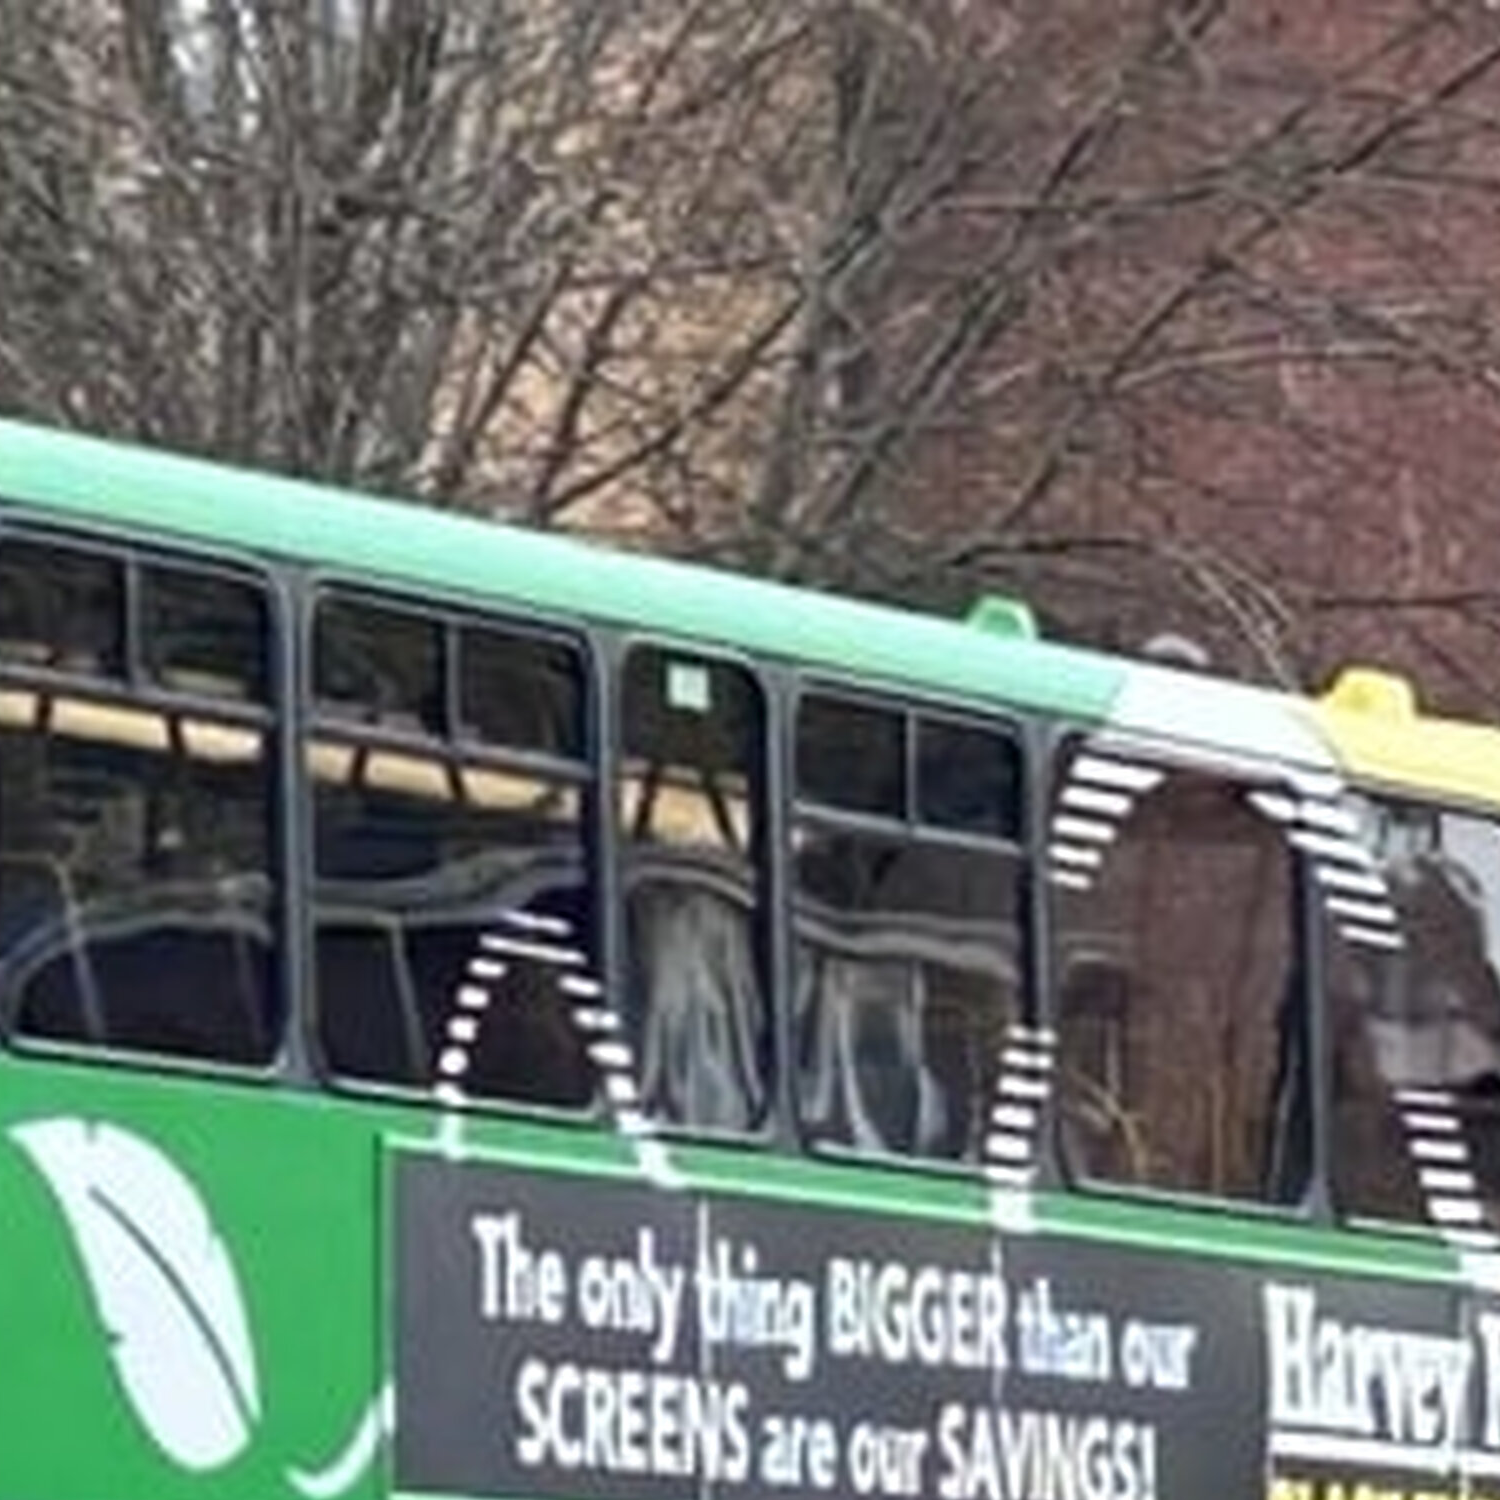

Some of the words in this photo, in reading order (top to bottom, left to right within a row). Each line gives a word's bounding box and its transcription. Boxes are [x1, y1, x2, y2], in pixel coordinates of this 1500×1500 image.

[472, 1212, 566, 1323] The
[578, 1228, 684, 1363] only
[696, 1240, 815, 1381] thing
[827, 1257, 1008, 1369] BIGGER
[1015, 1278, 1112, 1381] than
[1120, 1317, 1195, 1389] our
[1263, 1283, 1473, 1474] Harvey
[515, 1357, 750, 1481] SCREENS
[761, 1417, 837, 1489] are
[849, 1423, 927, 1496] our
